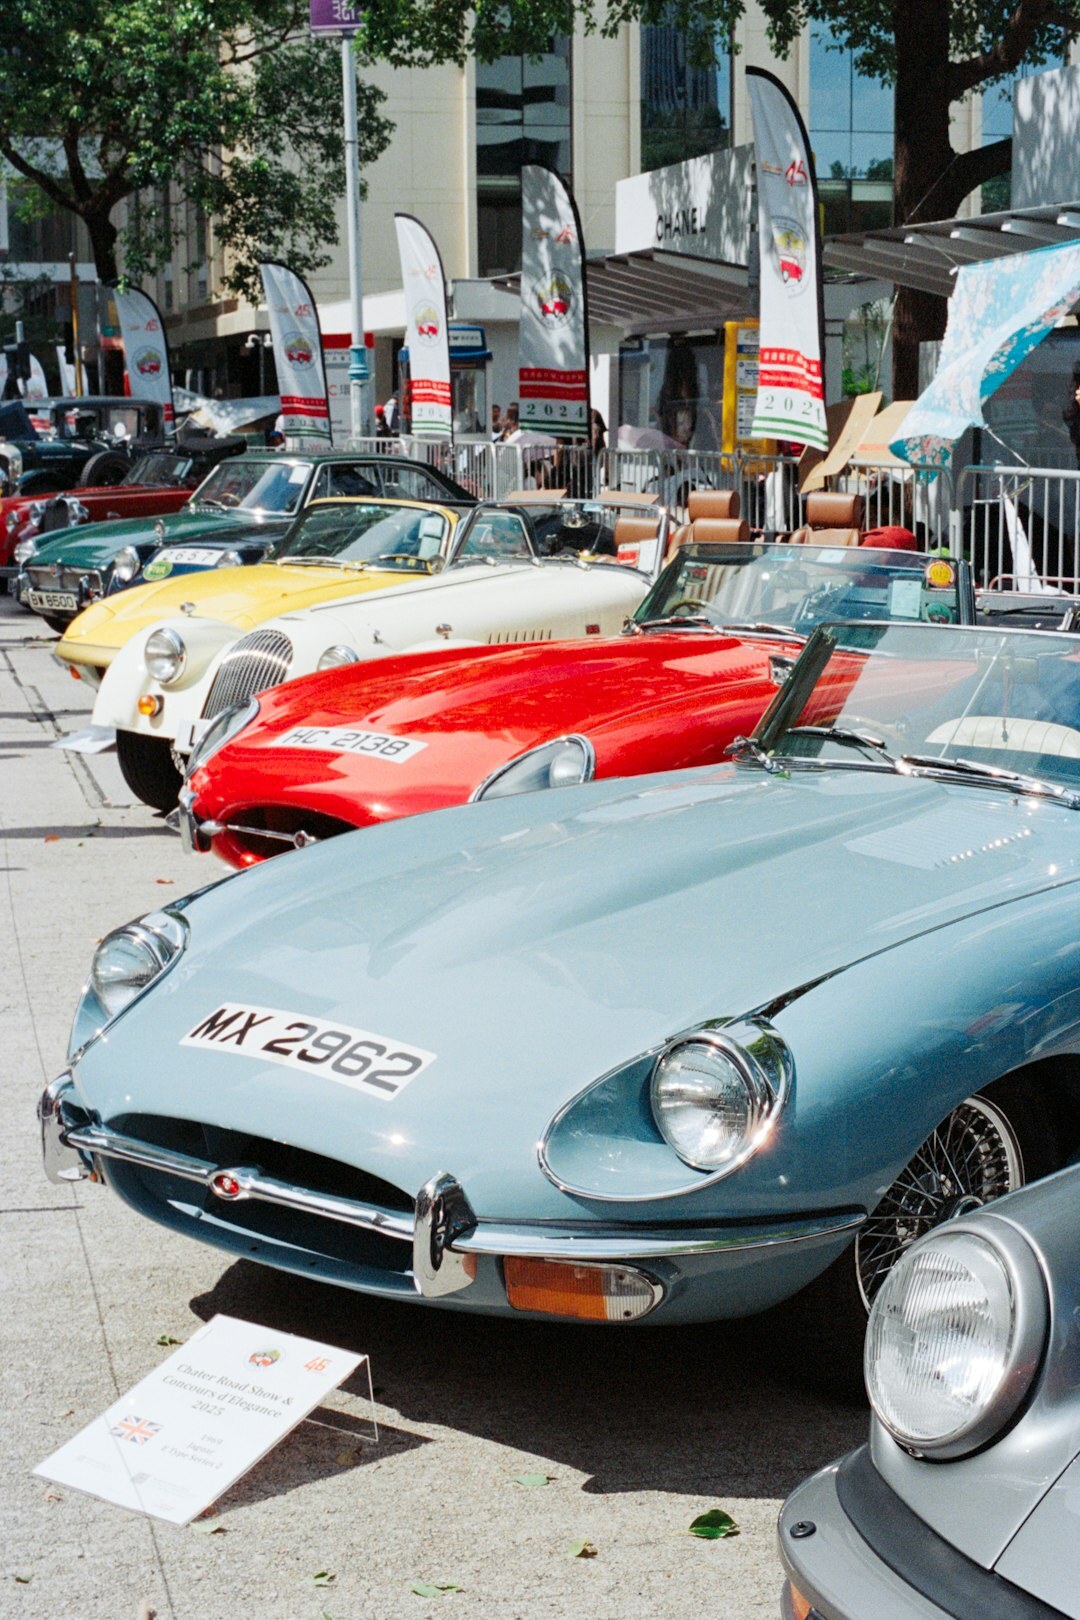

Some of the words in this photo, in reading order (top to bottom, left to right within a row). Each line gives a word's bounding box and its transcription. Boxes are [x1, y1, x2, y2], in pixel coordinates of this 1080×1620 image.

[656, 207, 706, 241] CHANEL
[526, 403, 584, 418] 2024
[30, 594, 44, 606] BW
[46, 595, 75, 608] 8500
[283, 729, 330, 744] HC
[331, 732, 410, 756] 2138
[190, 1008, 275, 1046] MX
[261, 1022, 423, 1093] 2962
[304, 1356, 333, 1372] 46
[162, 1375, 216, 1398] Concours
[217, 1392, 282, 1418] d'Elegance
[177, 1363, 217, 1381] Chater
[217, 1376, 250, 1391] Road
[248, 1385, 283, 1401] Show
[282, 1396, 294, 1406] &
[191, 1400, 226, 1416] 2025
